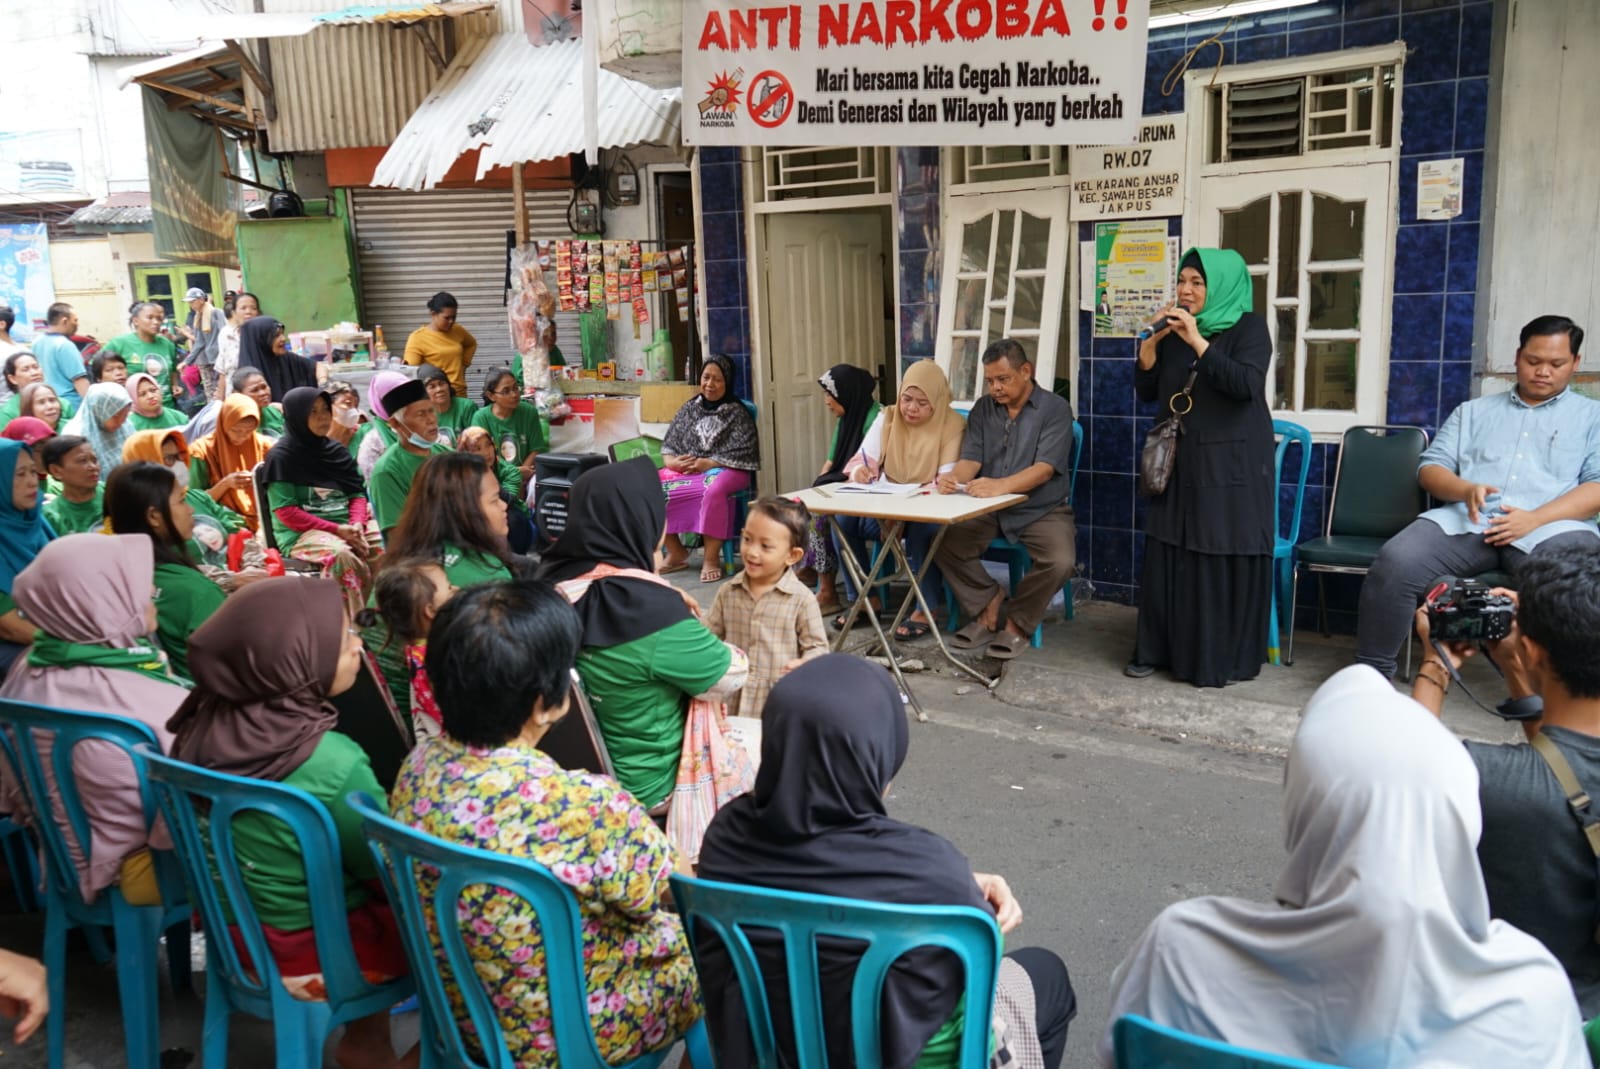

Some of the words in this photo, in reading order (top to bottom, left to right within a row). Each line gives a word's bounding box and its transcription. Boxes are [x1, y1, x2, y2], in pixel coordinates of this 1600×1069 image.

[699, 4, 801, 52] ANTI
[818, 0, 1071, 49] NARKOBA
[816, 67, 848, 92] Mari
[853, 67, 919, 91] bersama
[923, 64, 954, 90] kita
[958, 62, 1011, 95] Cegah
[1016, 59, 1100, 88] Narkoba..
[700, 111, 733, 120] LAWAN
[797, 99, 834, 124] Demi
[838, 98, 904, 124] Generasi
[907, 98, 937, 123] dan
[942, 96, 1009, 128] Wilayah
[1013, 101, 1057, 128] yang
[1061, 93, 1123, 120] berkah
[700, 120, 735, 128] NARKOBA
[1103, 149, 1152, 170] RW.07
[1096, 176, 1140, 190] KARANG
[1143, 173, 1180, 187] ANYAR
[1079, 192, 1100, 204] KEC.
[1102, 189, 1136, 203] SAWAH
[1138, 186, 1174, 200] BESAR
[1099, 200, 1152, 214] JAKPUS
